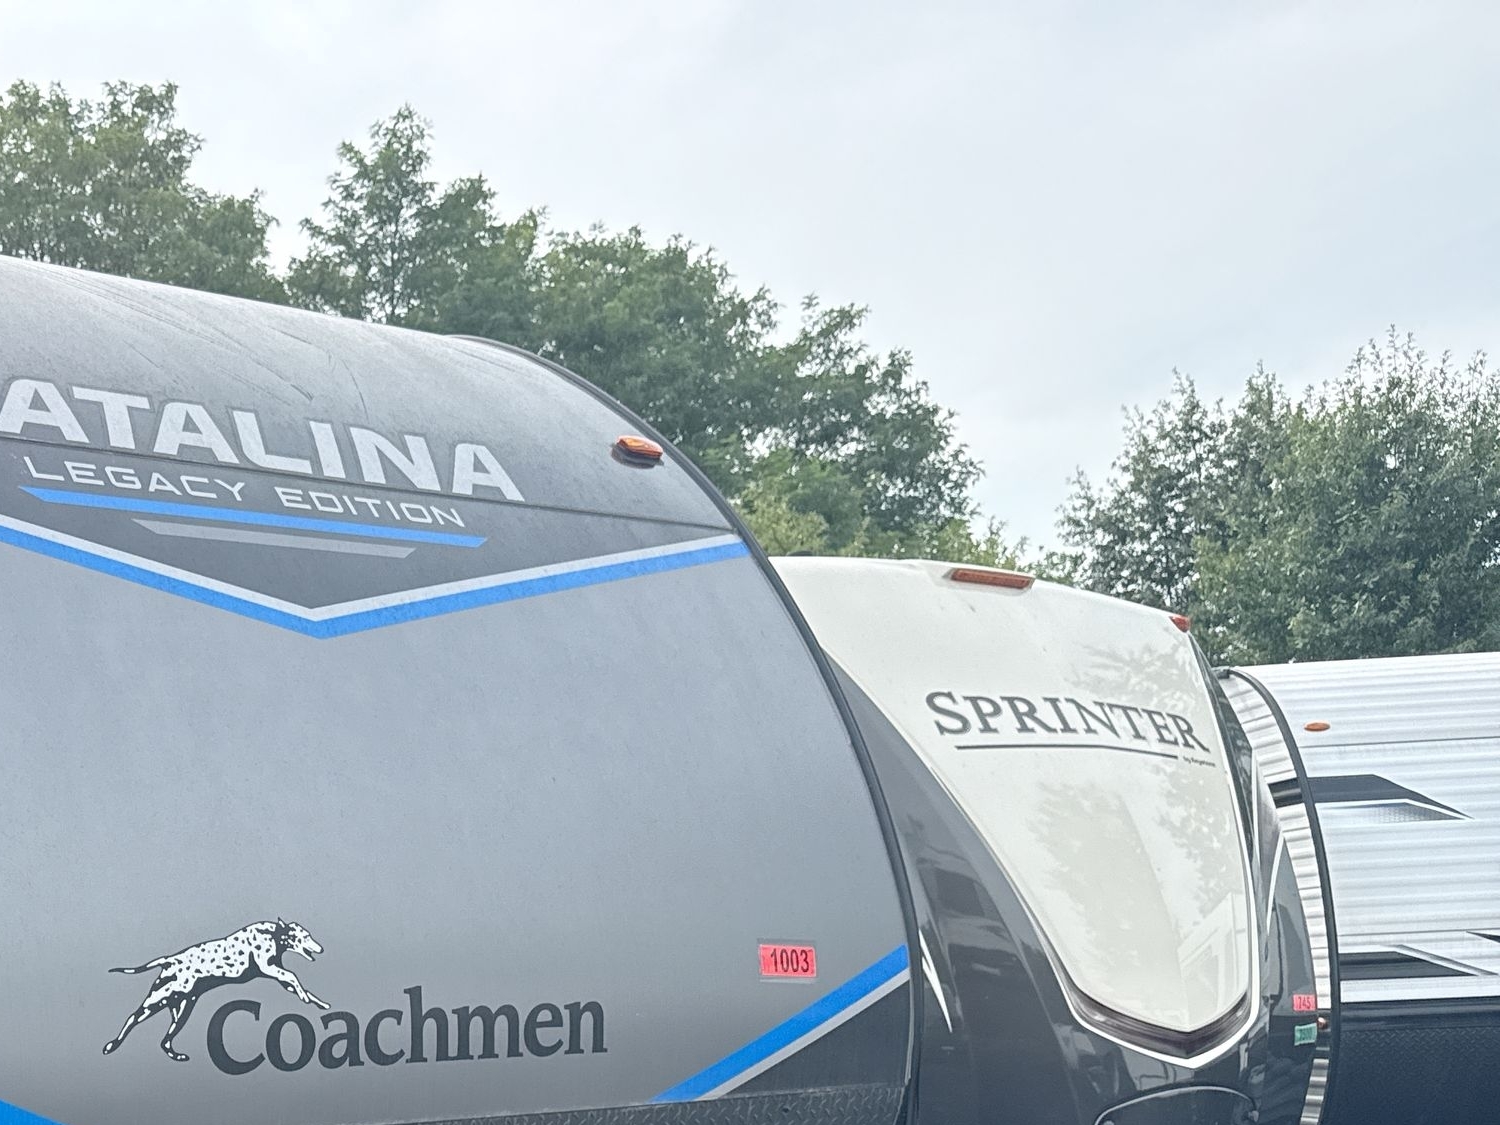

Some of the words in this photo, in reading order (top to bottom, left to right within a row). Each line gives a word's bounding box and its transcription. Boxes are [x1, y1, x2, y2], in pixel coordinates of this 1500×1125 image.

[22, 456, 246, 501] LEGACY
[275, 486, 466, 528] EDITION
[925, 690, 1211, 754] SPRINTER
[770, 948, 810, 973] 1003
[206, 985, 608, 1076] Coachmen
